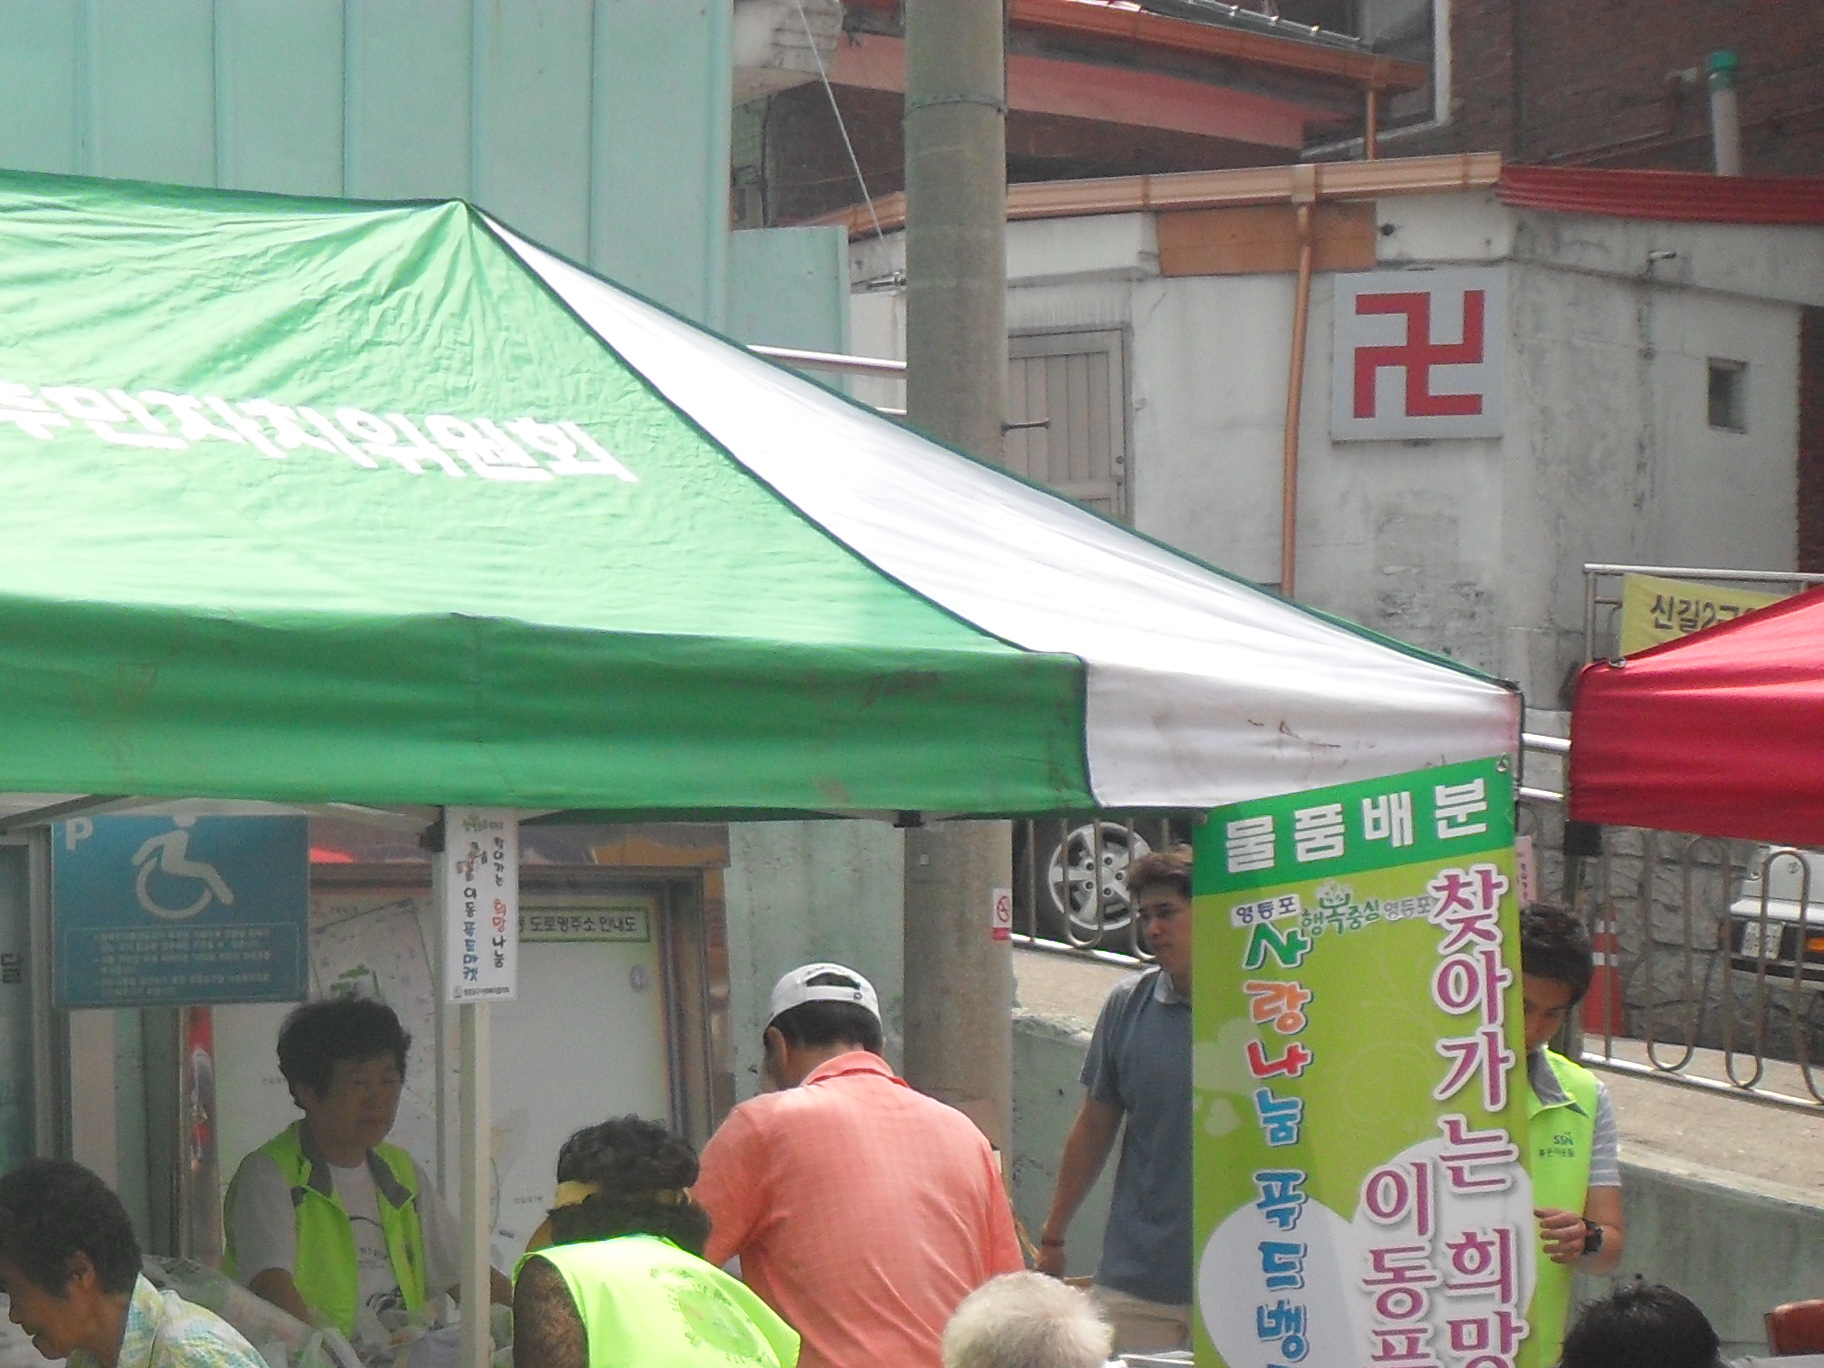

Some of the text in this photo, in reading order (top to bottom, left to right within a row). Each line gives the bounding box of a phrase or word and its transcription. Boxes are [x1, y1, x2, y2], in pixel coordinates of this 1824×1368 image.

[65, 817, 93, 850] P
[1226, 778, 1489, 874] 물품배분
[530, 915, 637, 933] 도로명주소 안내도
[1236, 894, 1298, 925] 영등포
[1, 953, 23, 983] 달
[1244, 924, 1314, 1146] 사랑나눔
[1432, 866, 1514, 1189] 찾아가는
